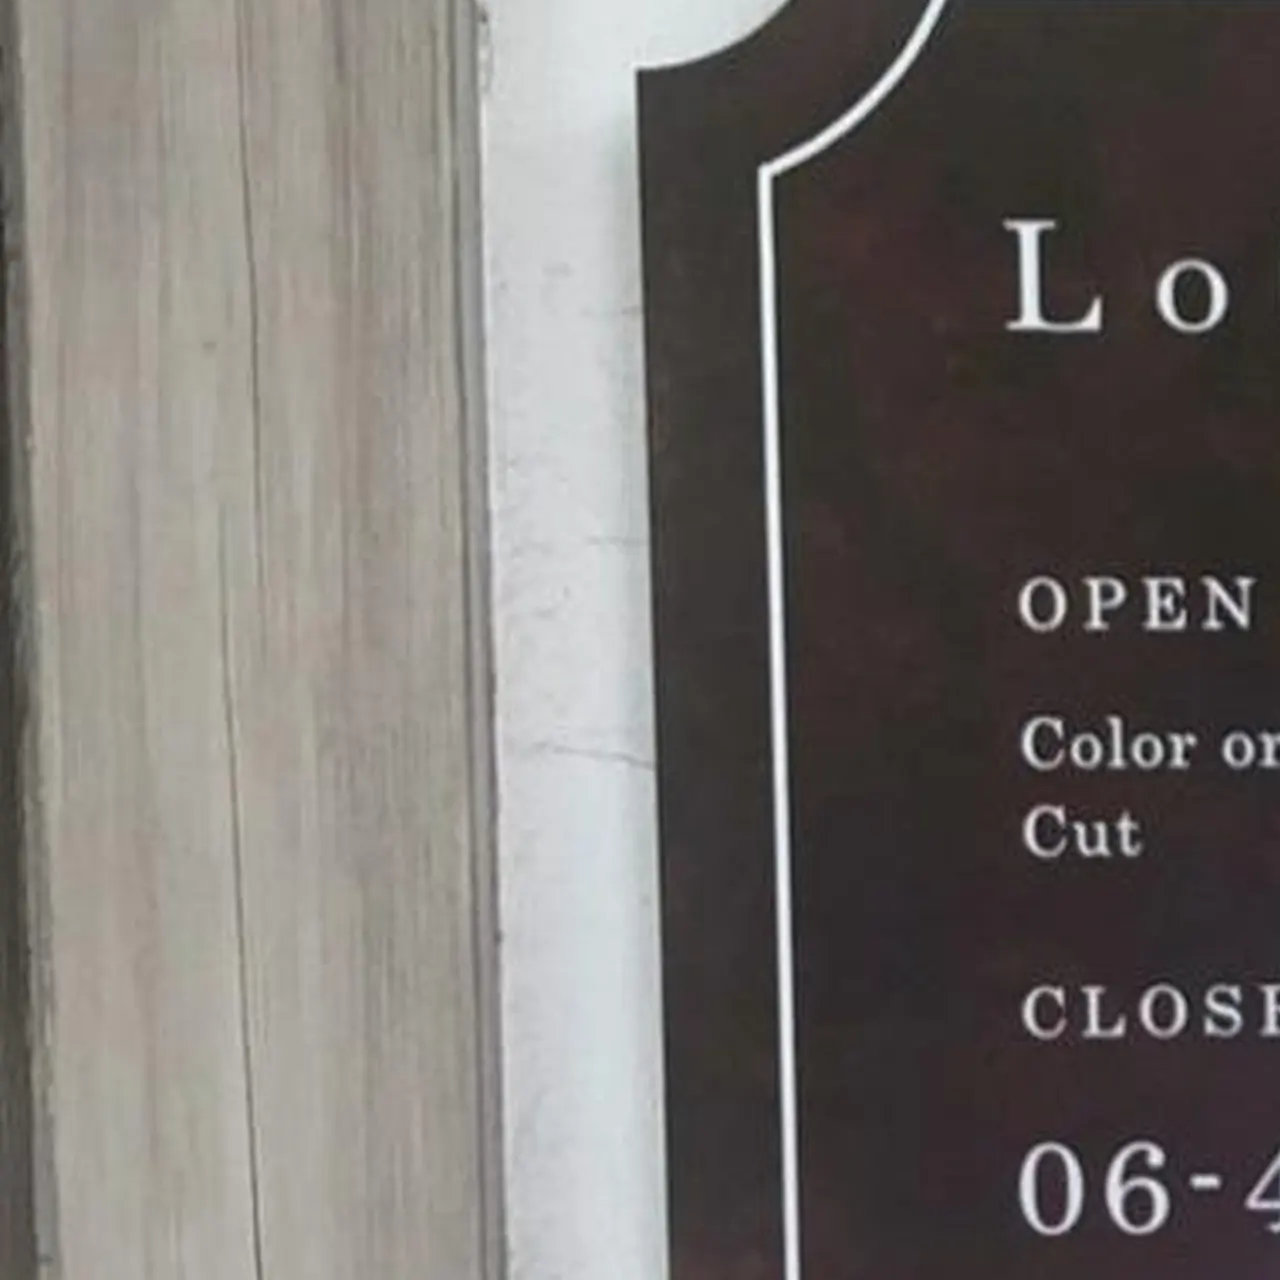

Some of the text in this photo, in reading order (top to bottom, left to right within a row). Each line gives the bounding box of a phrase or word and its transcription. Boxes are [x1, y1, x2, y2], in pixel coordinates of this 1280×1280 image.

[1018, 576, 1256, 632] OPEN
[1020, 716, 1197, 770] Color
[1022, 804, 1142, 858] Cut
